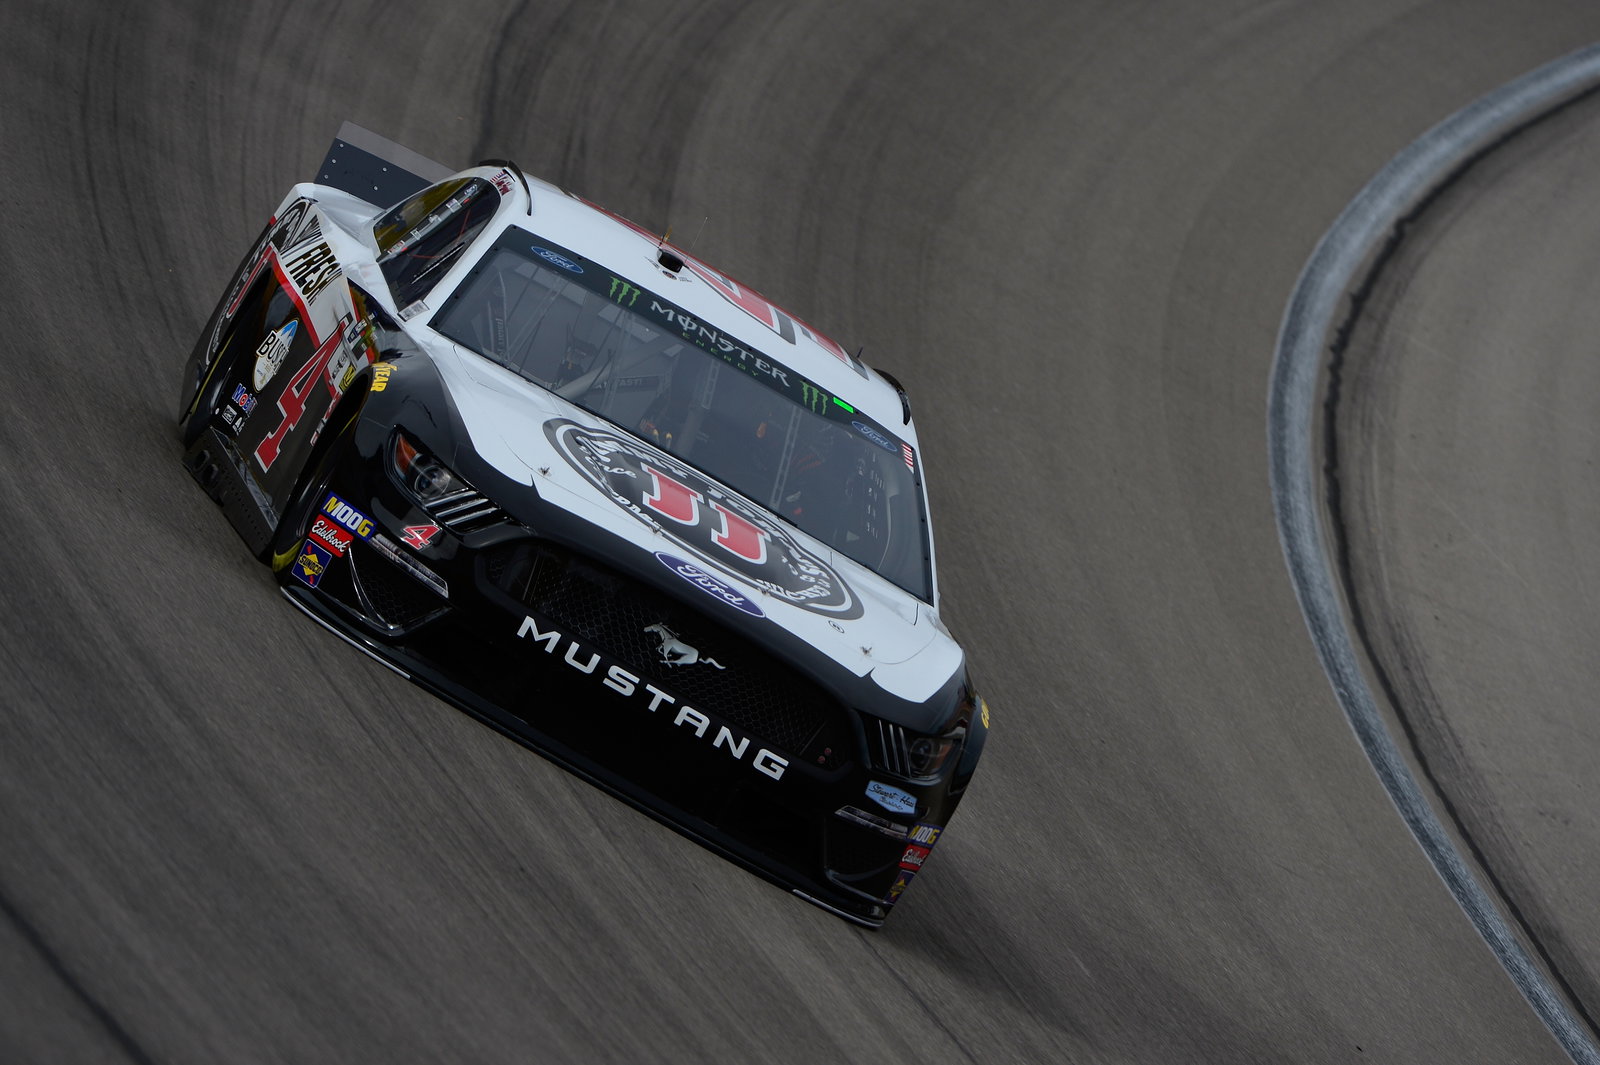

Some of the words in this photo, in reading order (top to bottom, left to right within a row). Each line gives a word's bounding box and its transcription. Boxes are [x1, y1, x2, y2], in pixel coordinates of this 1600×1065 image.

[285, 241, 343, 307] FRESH
[541, 250, 577, 269] Ford
[650, 300, 791, 388] MONSTER
[254, 312, 353, 474] 4
[860, 425, 890, 448] Ford
[322, 495, 375, 538] MOOG
[311, 519, 351, 554] Edelbrock
[402, 523, 442, 551] 4
[299, 555, 324, 576] SUNOCO
[676, 563, 745, 606] Ford
[516, 614, 790, 782] MUSTANG
[906, 825, 941, 845] MOOG
